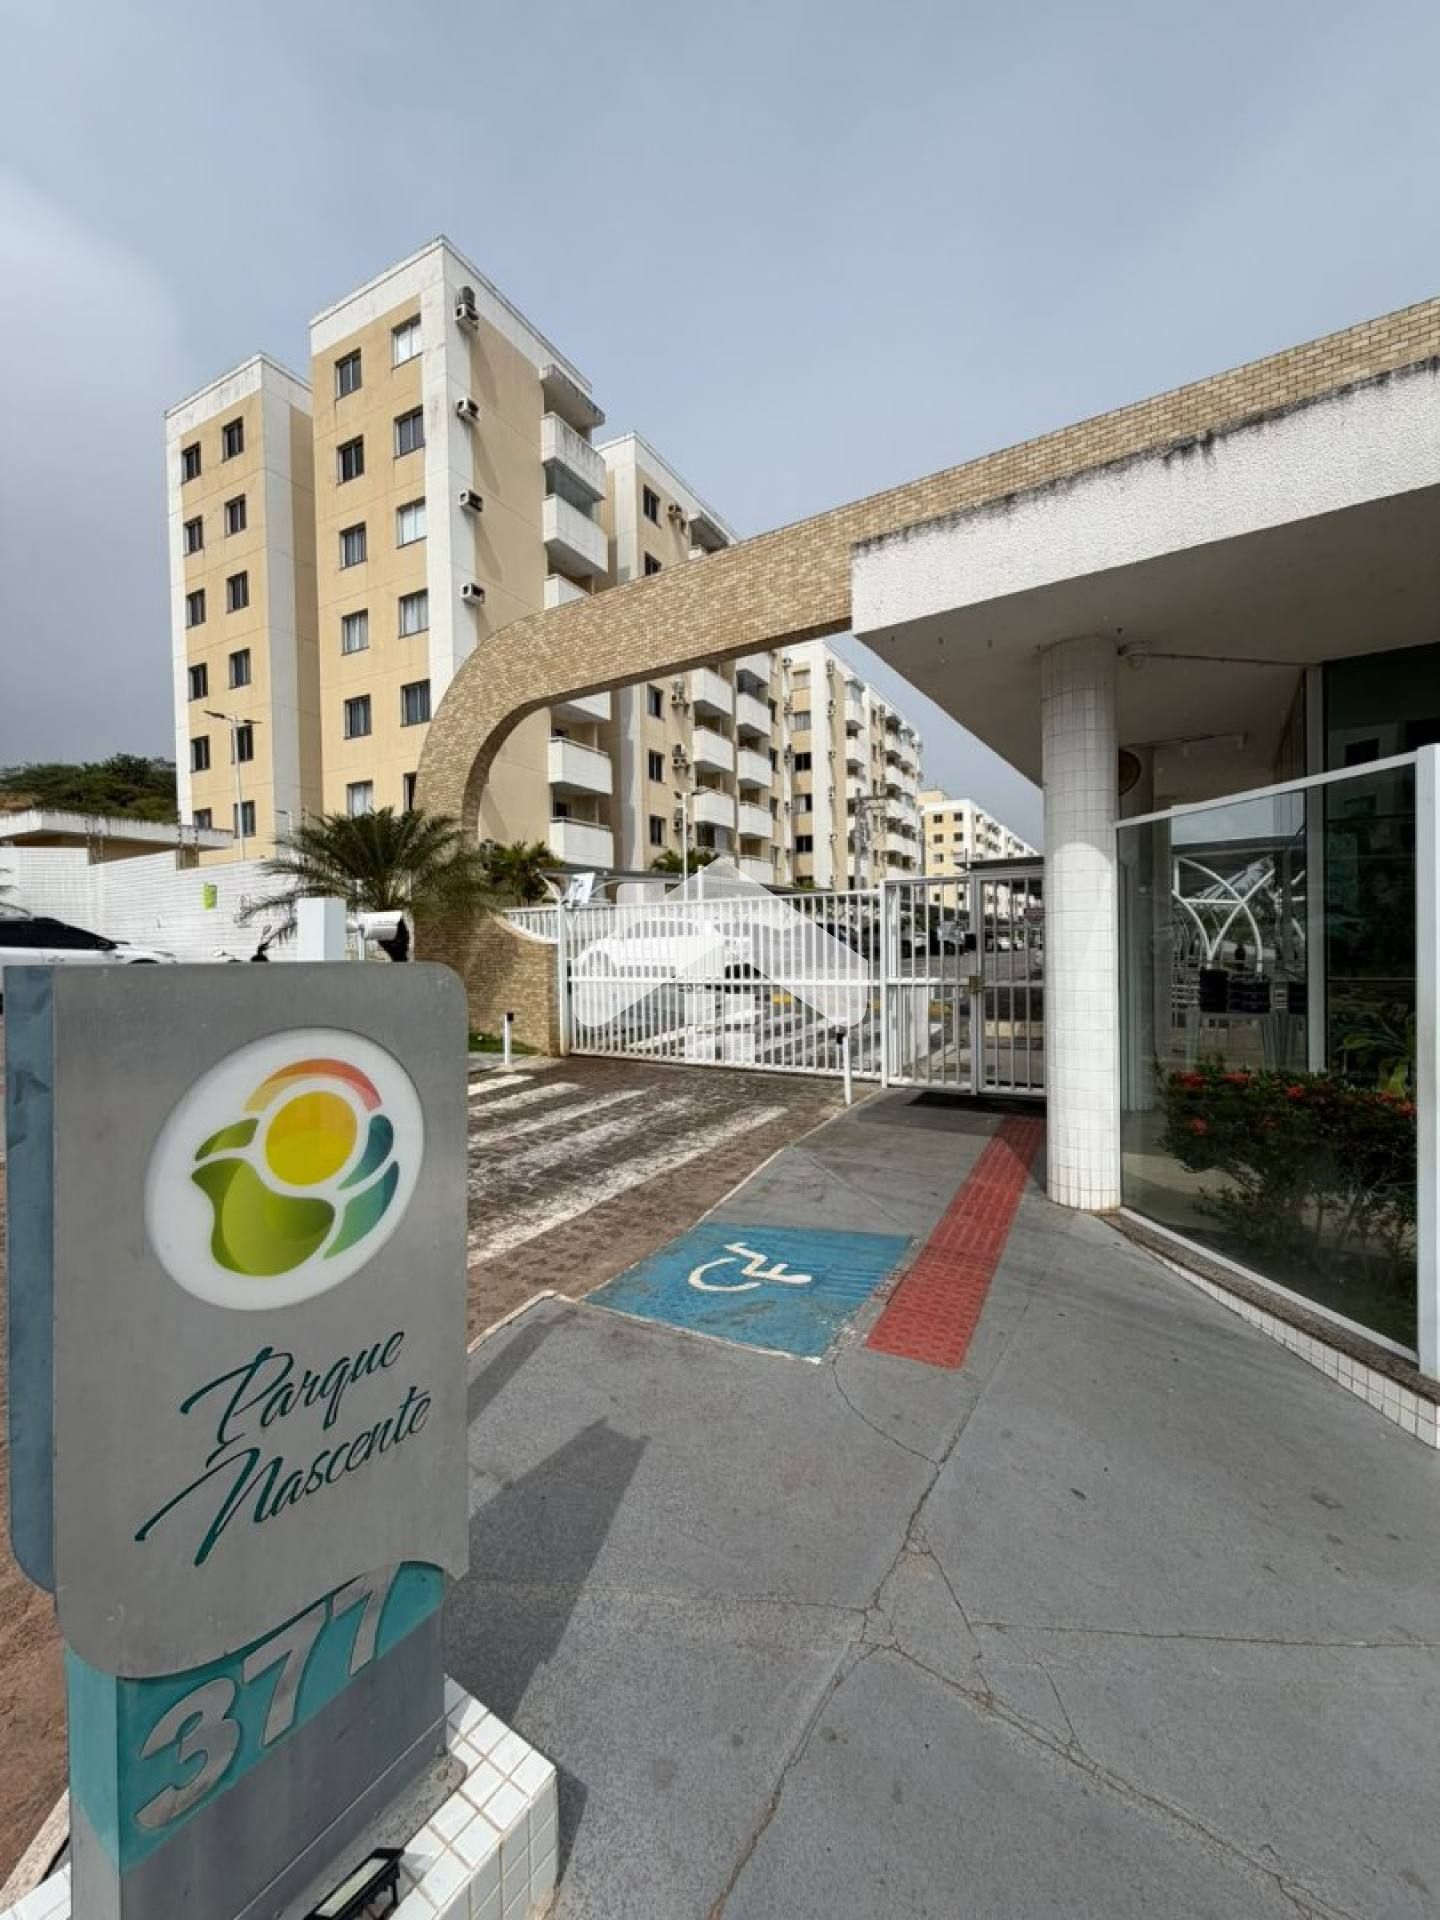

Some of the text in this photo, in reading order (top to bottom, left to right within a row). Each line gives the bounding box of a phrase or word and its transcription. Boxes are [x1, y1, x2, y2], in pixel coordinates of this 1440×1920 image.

[134, 1385, 431, 1566] Nascente
[179, 1331, 405, 1446] Parque
[135, 1563, 402, 1829] 377
